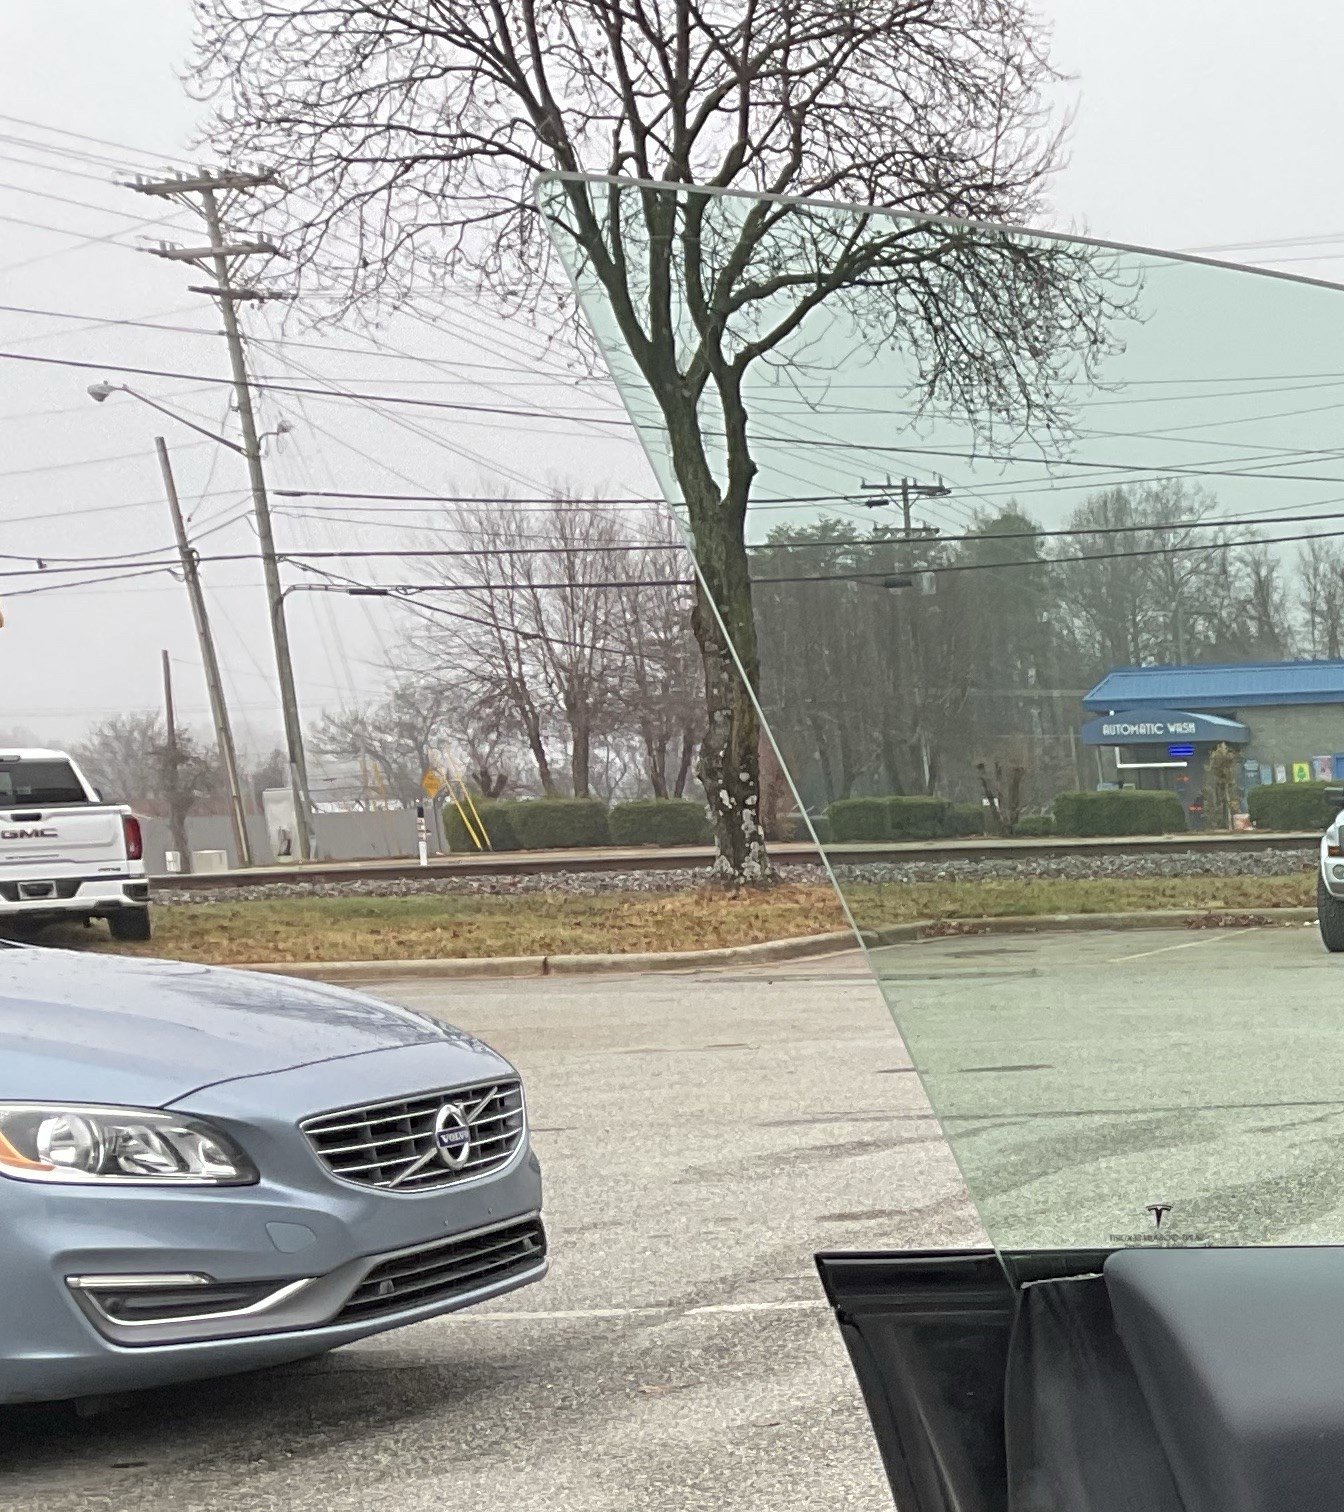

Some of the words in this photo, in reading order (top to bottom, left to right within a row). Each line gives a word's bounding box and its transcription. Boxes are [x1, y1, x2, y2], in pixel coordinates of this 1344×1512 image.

[1102, 723, 1164, 736] AUTOMATIC
[1167, 722, 1196, 734] WASH
[1, 827, 58, 839] GMC
